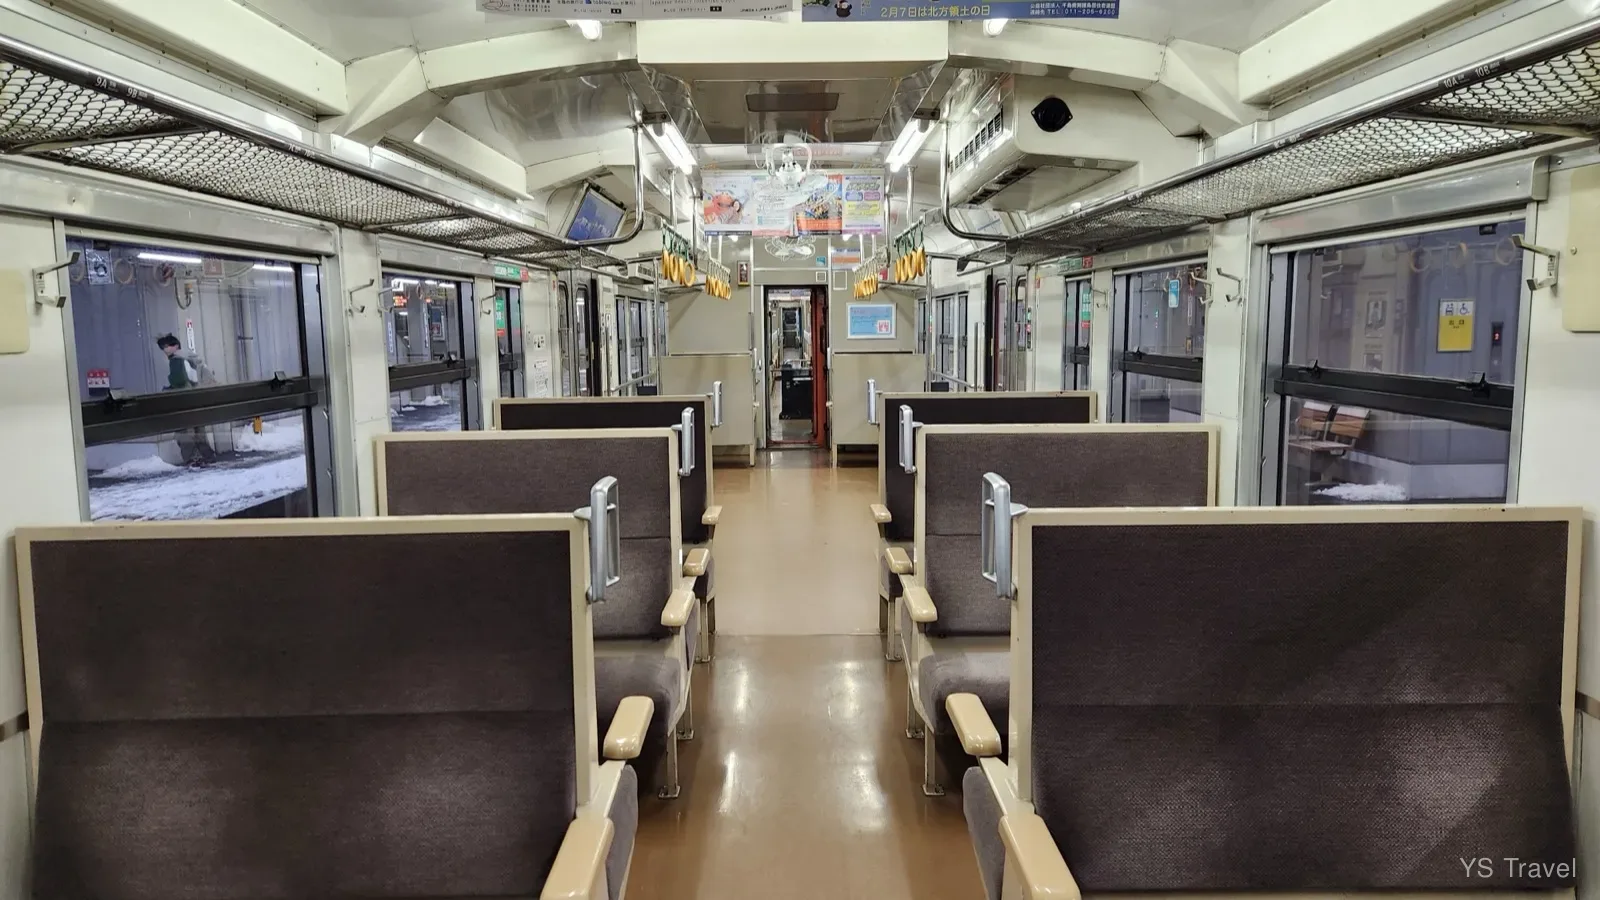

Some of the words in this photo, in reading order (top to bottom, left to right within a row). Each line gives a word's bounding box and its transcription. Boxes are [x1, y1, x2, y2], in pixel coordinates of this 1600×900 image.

[880, 5, 990, 18] 2月7日は北方領土の日
[95, 76, 107, 89] 9A
[126, 87, 138, 99] 9B
[1443, 77, 1459, 88] 10A
[1475, 65, 1490, 77] 10B
